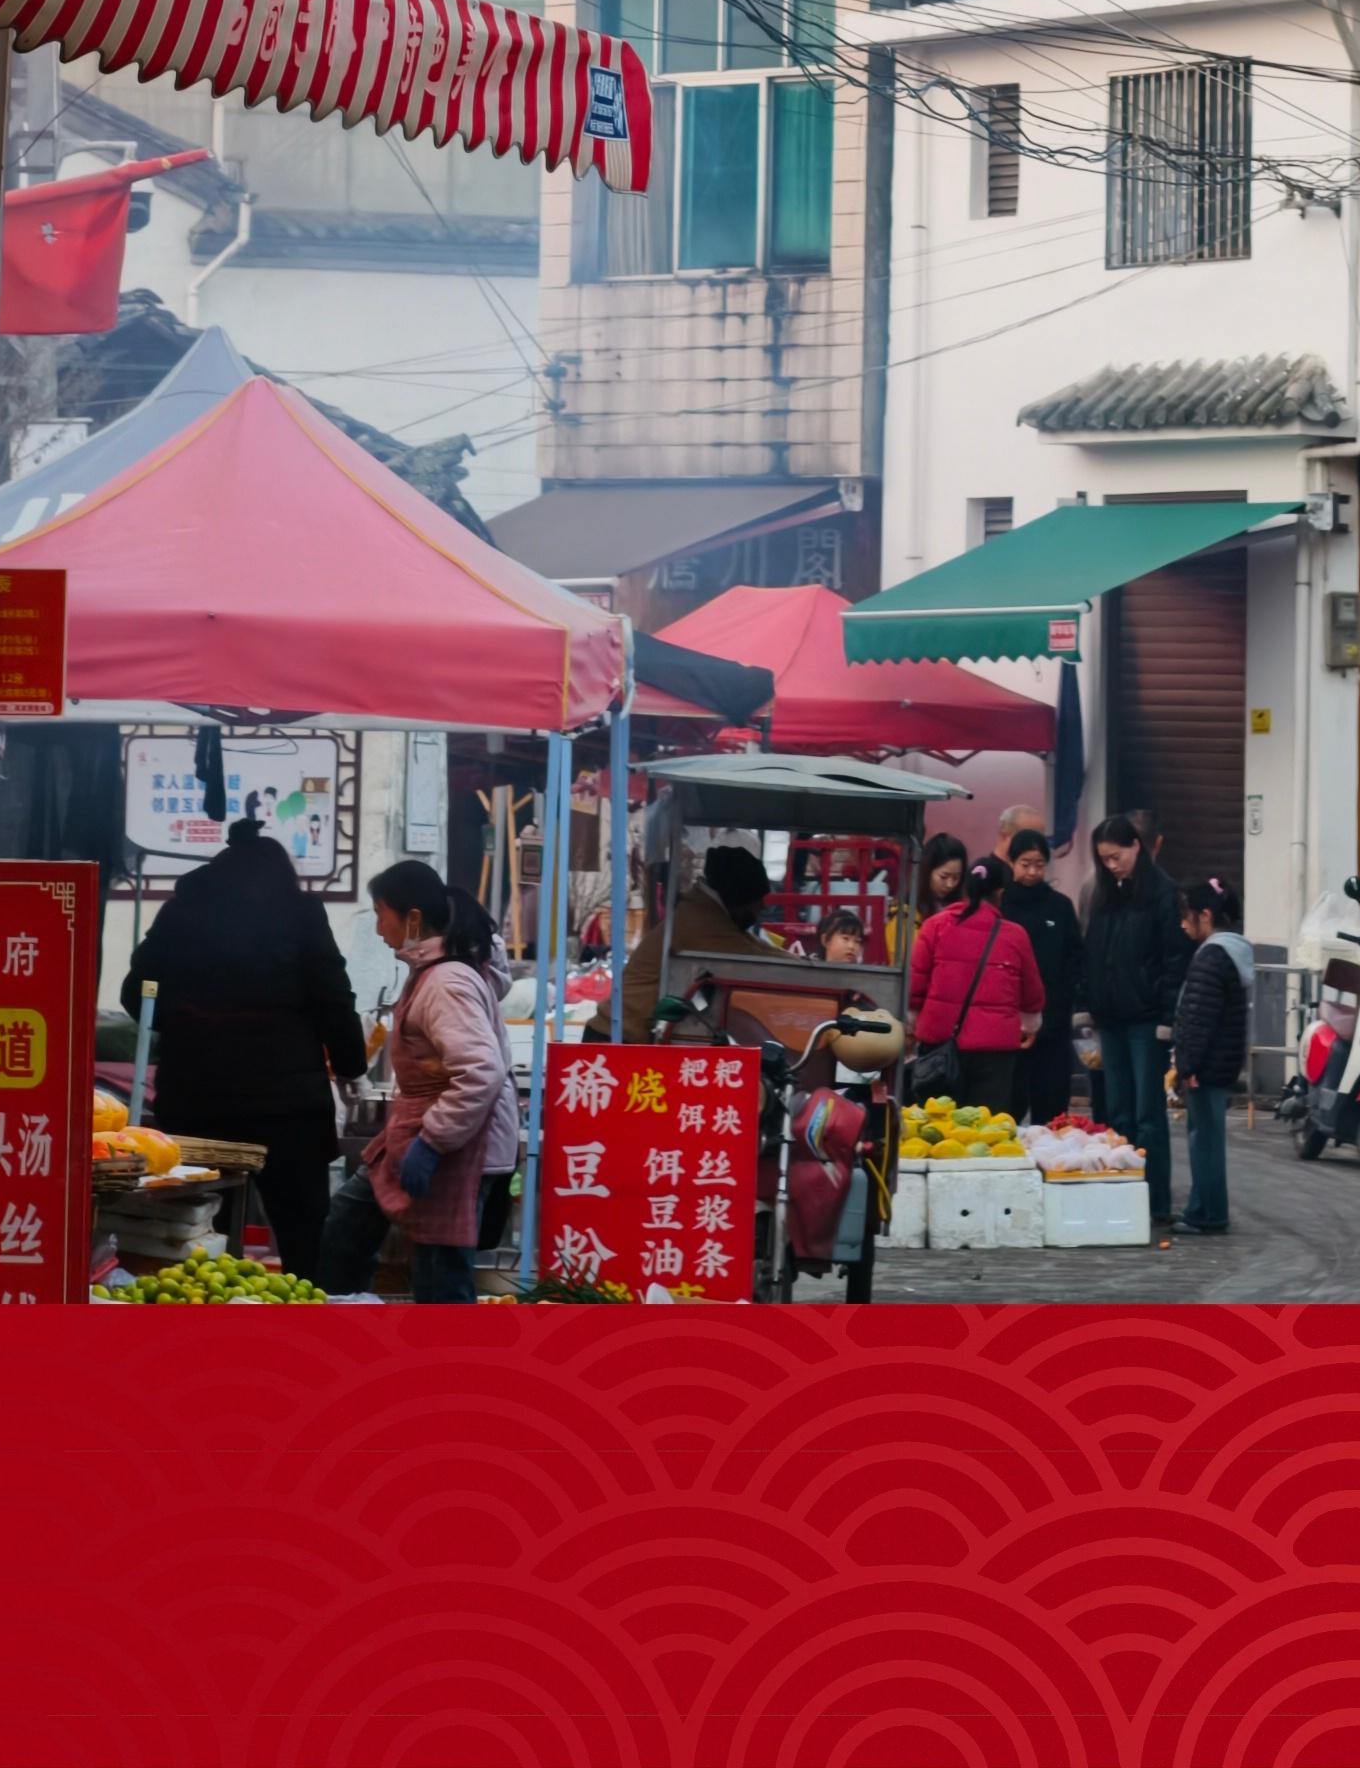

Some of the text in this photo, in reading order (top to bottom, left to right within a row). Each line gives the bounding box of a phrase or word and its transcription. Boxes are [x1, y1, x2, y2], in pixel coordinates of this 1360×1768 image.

[677, 1103, 743, 1136] 饵块
[644, 1147, 737, 1187] 饵丝
[642, 1194, 735, 1233] 豆浆
[640, 1238, 735, 1279] 油条
